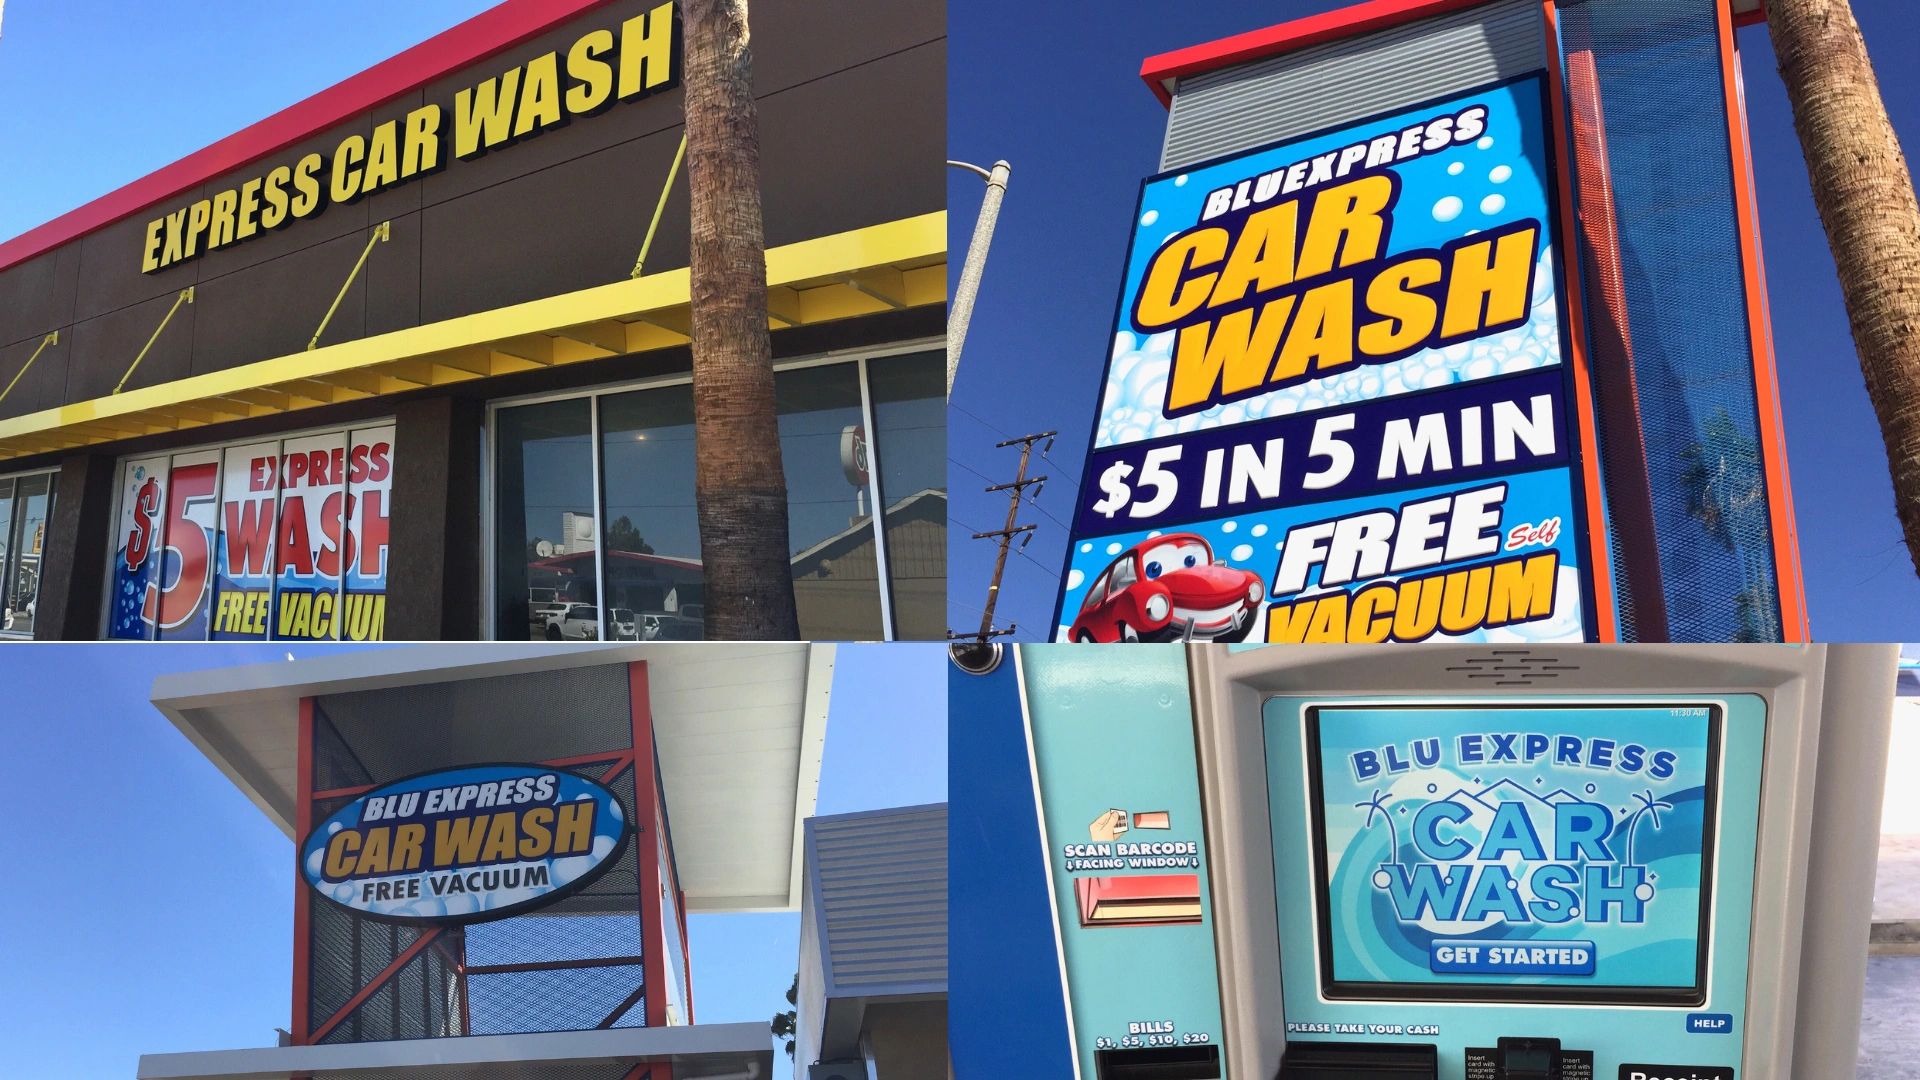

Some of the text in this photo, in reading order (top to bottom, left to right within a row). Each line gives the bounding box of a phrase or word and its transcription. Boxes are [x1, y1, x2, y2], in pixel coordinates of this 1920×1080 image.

[142, 1, 675, 274] EXPRESS CAR WASH
[1201, 107, 1487, 221] BLUEXPRESS
[1136, 175, 1393, 327] CAR
[1168, 227, 1536, 411] WASH
[249, 442, 391, 492] EXPRESS
[1092, 394, 1557, 519] $5 IN 5 MIN
[122, 462, 219, 629] $5
[1270, 486, 1506, 598] FREE
[1507, 518, 1560, 548] Self
[214, 592, 269, 633] FREE
[1265, 553, 1558, 643] VACUUM
[1670, 709, 1706, 717] 11:30 AM
[1352, 733, 1678, 779] BLU EXPRESS
[363, 775, 556, 822] BLU EXPRESS
[325, 801, 594, 878] CAR WASH
[1064, 841, 1197, 858] SCAN BARCODE
[1412, 801, 1615, 862] CAR
[361, 866, 549, 903] FREE VACUUM
[1075, 856, 1189, 870] FACING WINDOW
[1380, 864, 1646, 923] WASH
[1436, 946, 1589, 966] GET STARTED
[1096, 1032, 1209, 1049] $1, $5, $10, $20
[1129, 1021, 1174, 1034] BILLS
[1287, 1023, 1440, 1035] PLEASE TAKE YOUR CASH
[1694, 1019, 1725, 1028] HELP
